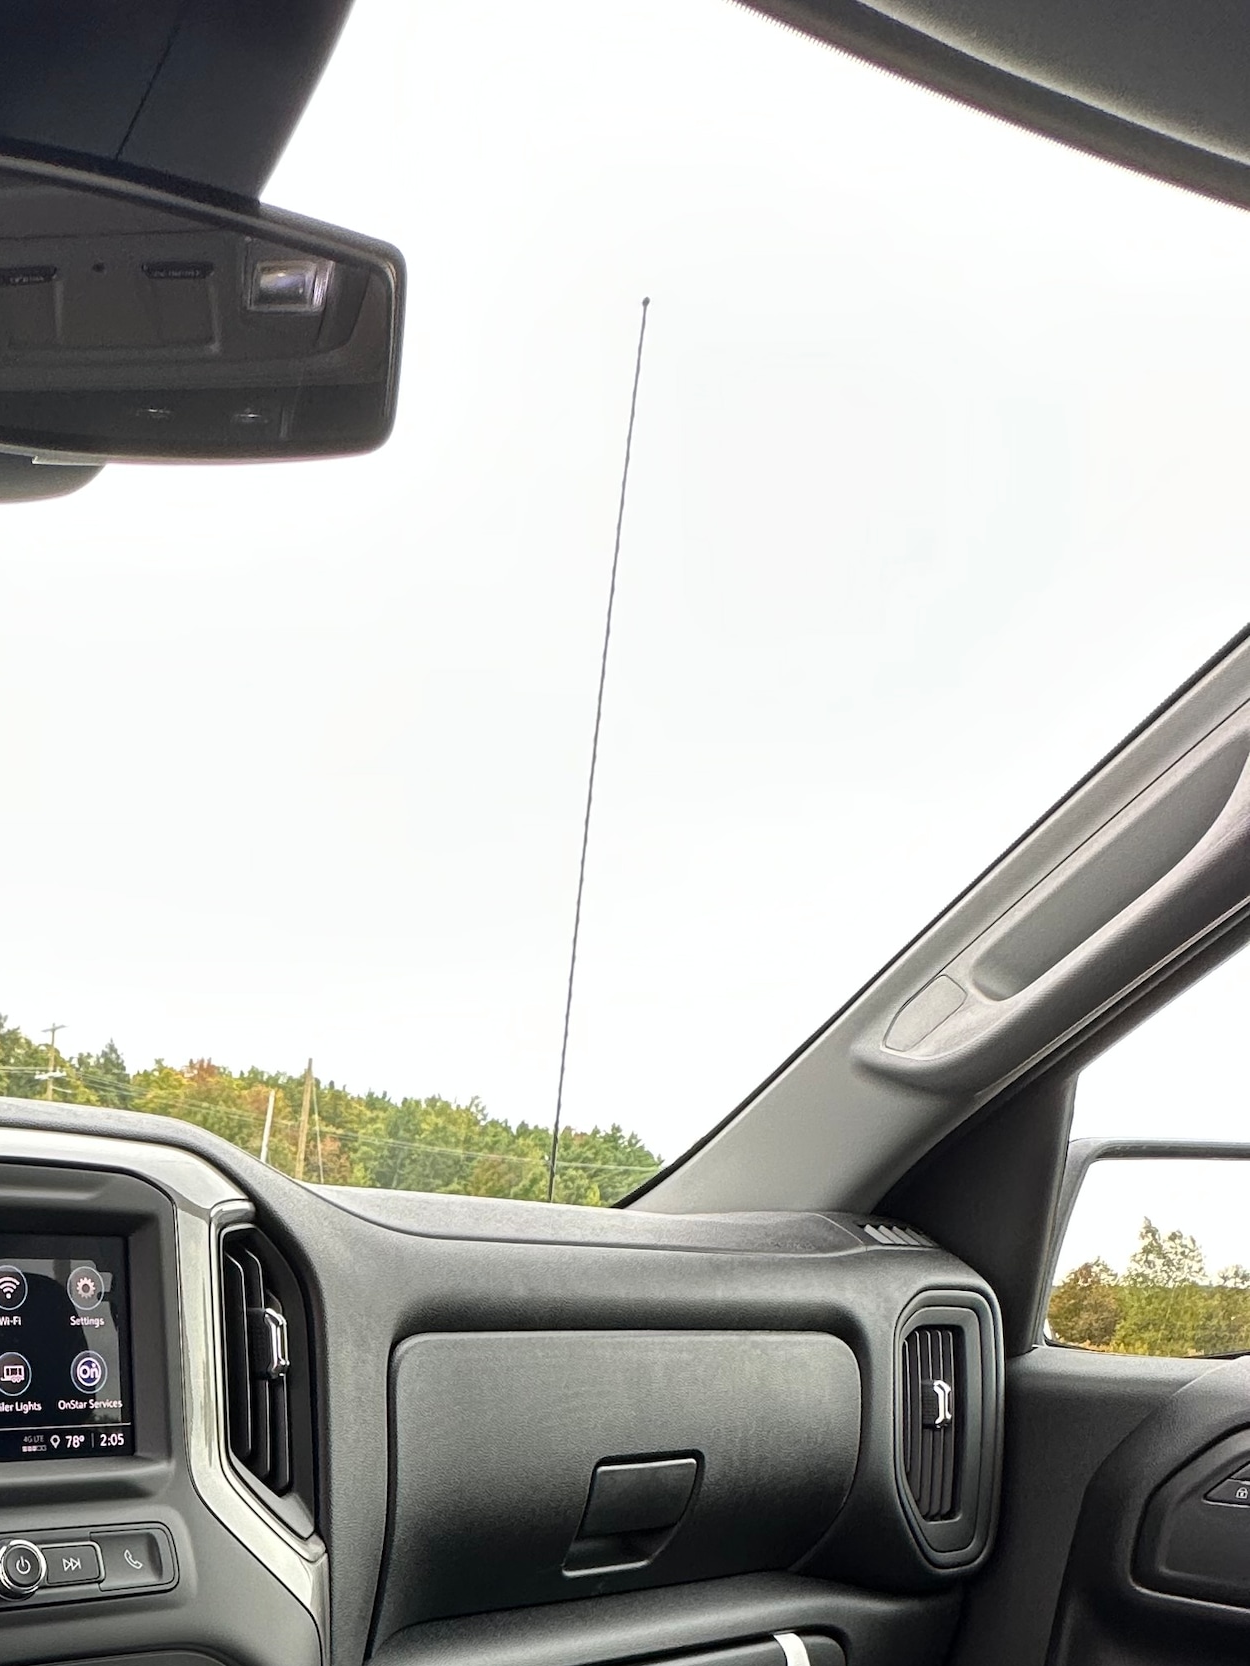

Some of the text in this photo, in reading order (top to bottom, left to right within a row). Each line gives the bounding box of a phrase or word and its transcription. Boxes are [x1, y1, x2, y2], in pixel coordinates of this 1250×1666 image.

[70, 1315, 105, 1328] Settings
[11, 1400, 42, 1413] Lights
[57, 1397, 123, 1411] OnStar Services
[23, 1434, 44, 1443] 4G LTE
[100, 1433, 125, 1447] 2:05
